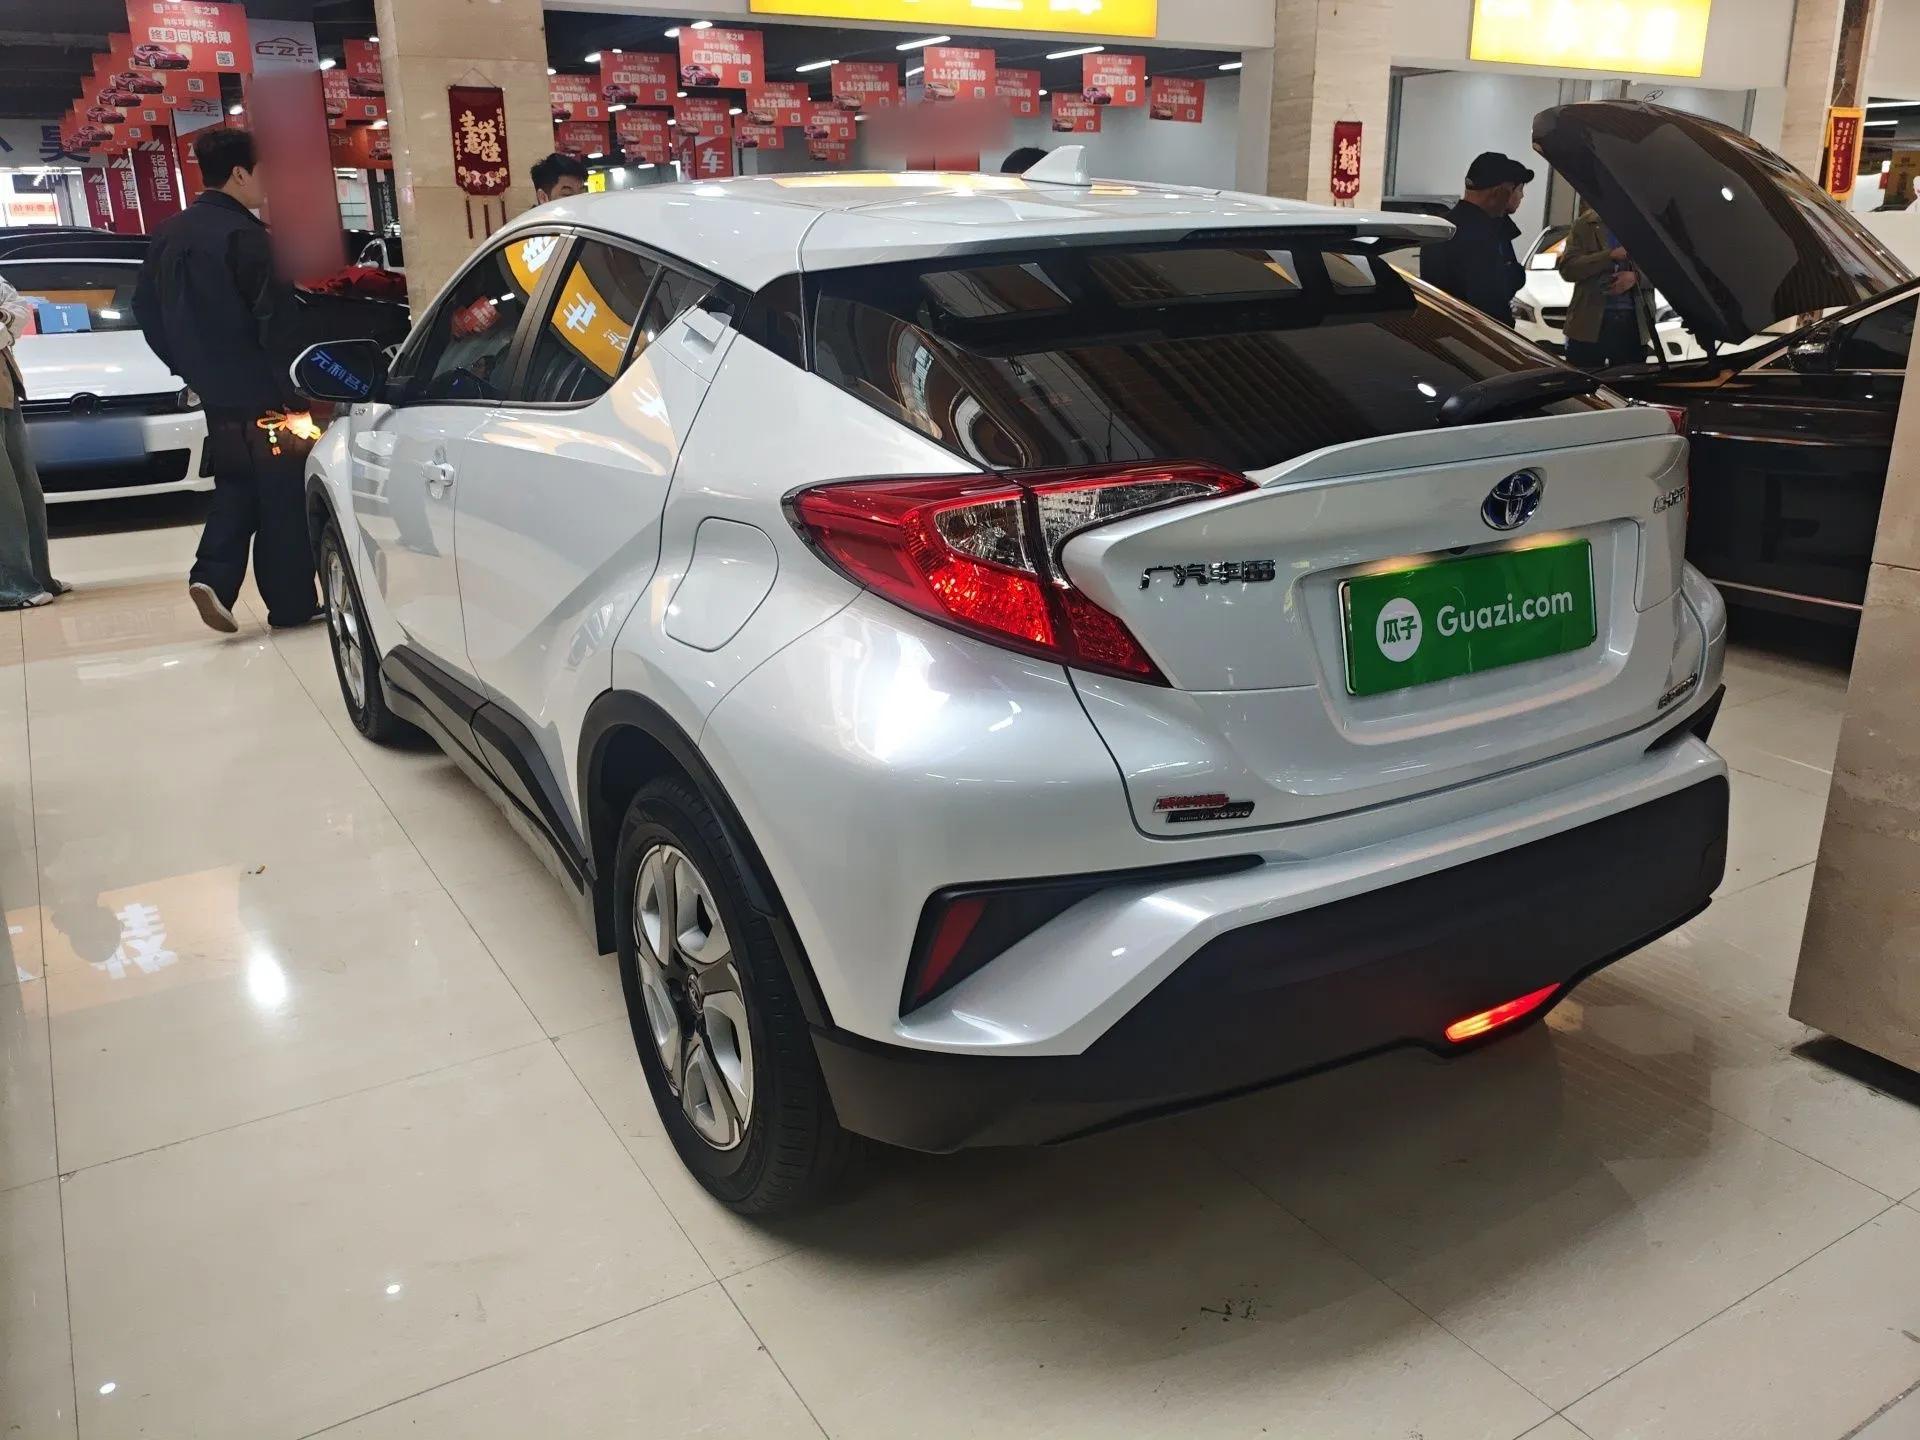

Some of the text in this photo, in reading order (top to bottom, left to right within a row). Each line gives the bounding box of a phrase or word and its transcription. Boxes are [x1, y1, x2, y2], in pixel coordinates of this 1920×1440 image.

[149, 28, 232, 44] 终身回购保障
[1436, 591, 1573, 637] Guazi.com
[1382, 615, 1418, 645] 瓜子
